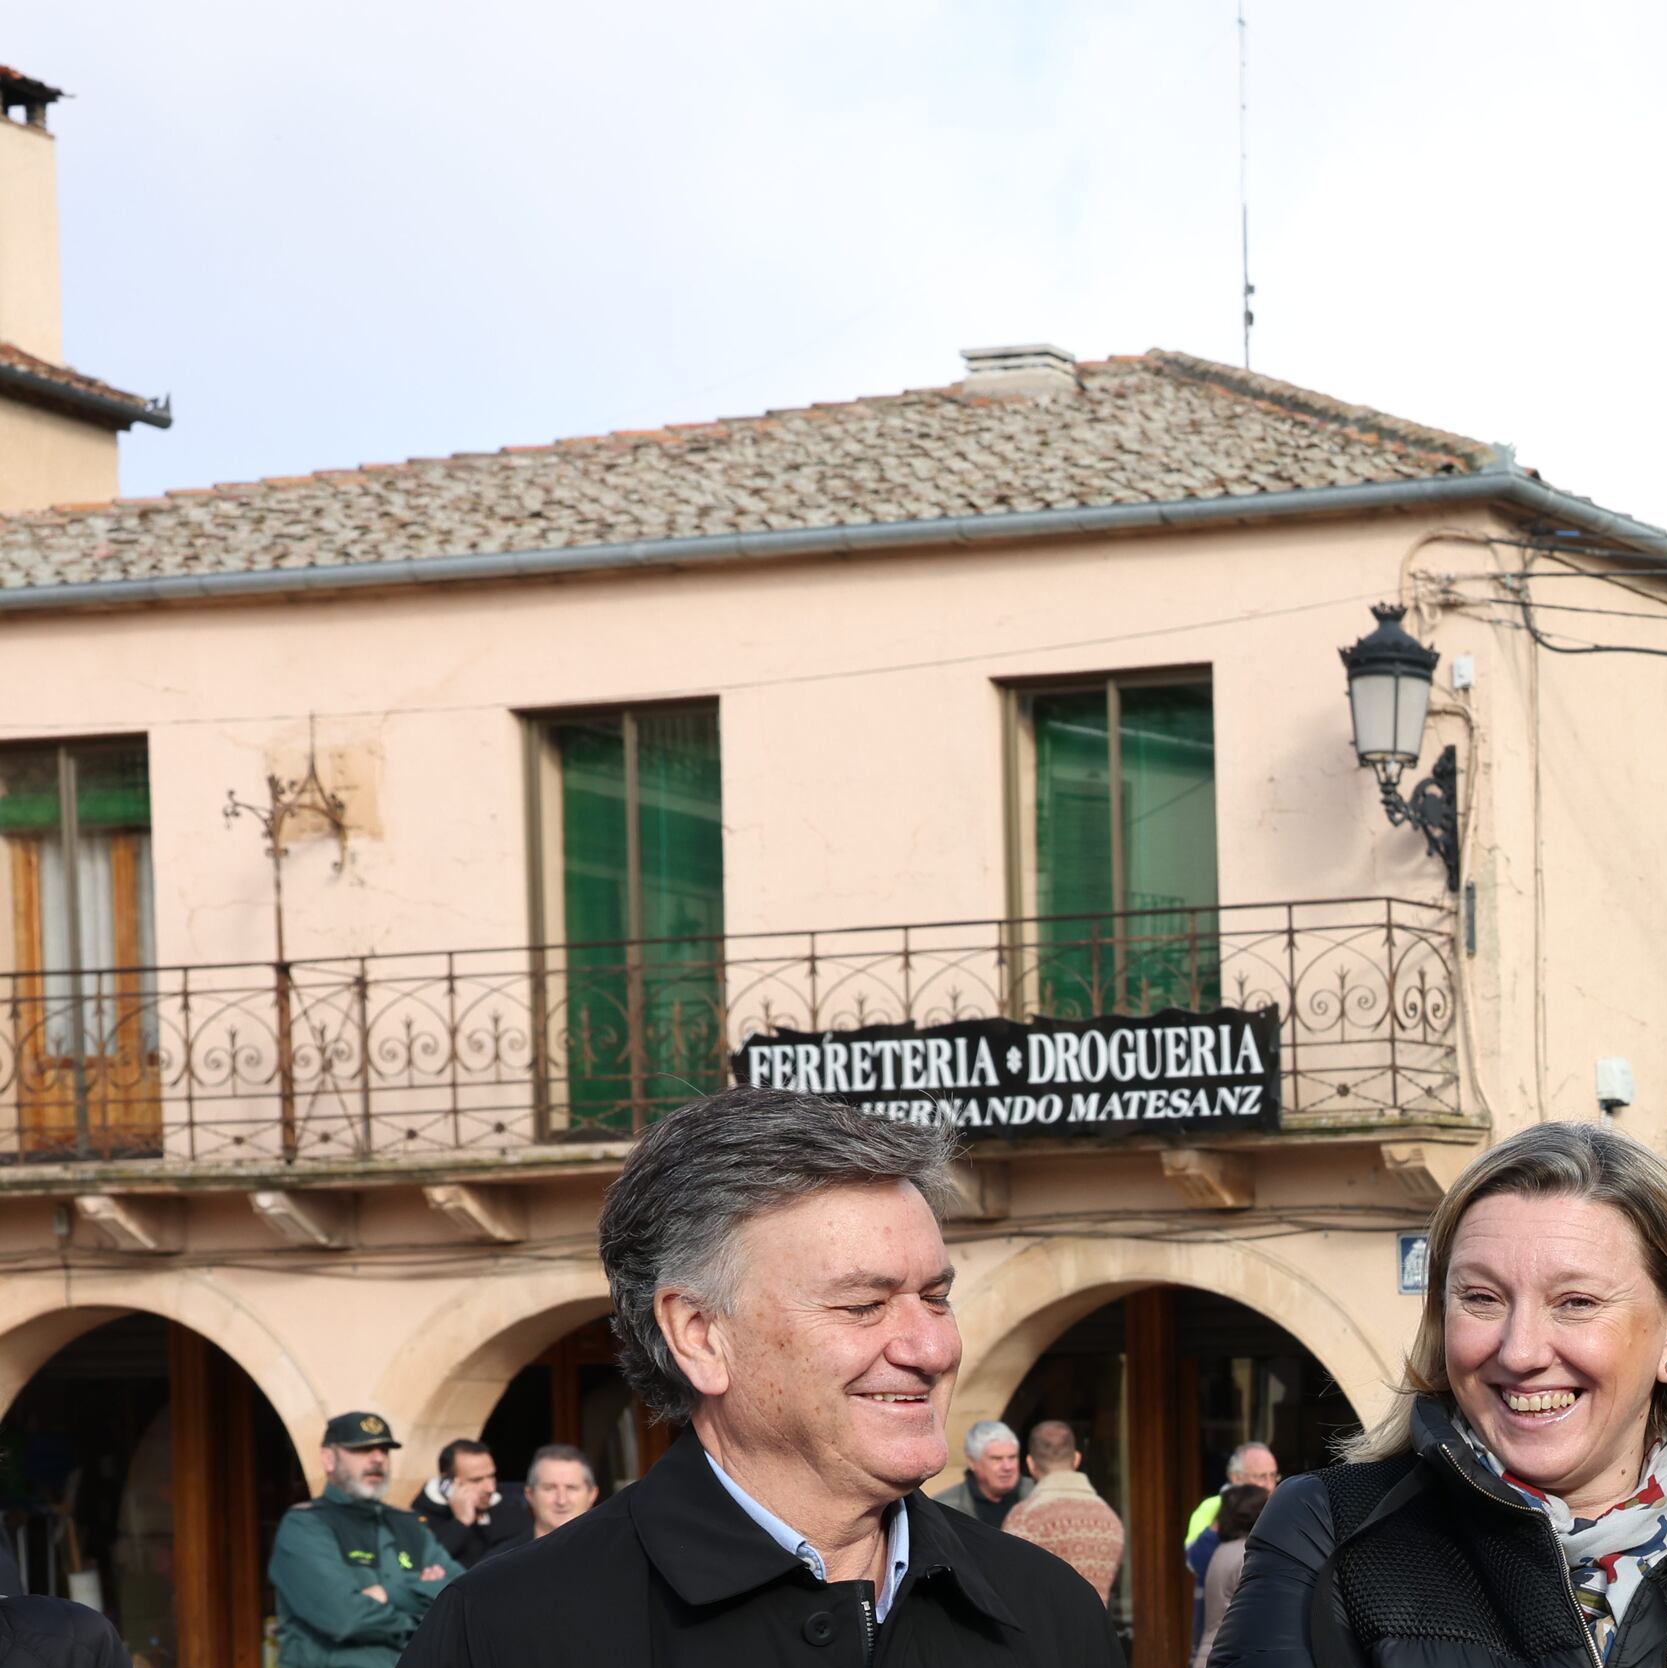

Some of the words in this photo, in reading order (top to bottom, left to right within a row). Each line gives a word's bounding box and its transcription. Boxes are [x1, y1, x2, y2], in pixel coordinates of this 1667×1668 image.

[749, 1036, 999, 1093] FERRETERIA
[1027, 1023, 1265, 1084] DROGUERIA
[1066, 1085, 1263, 1123] MATESANZ
